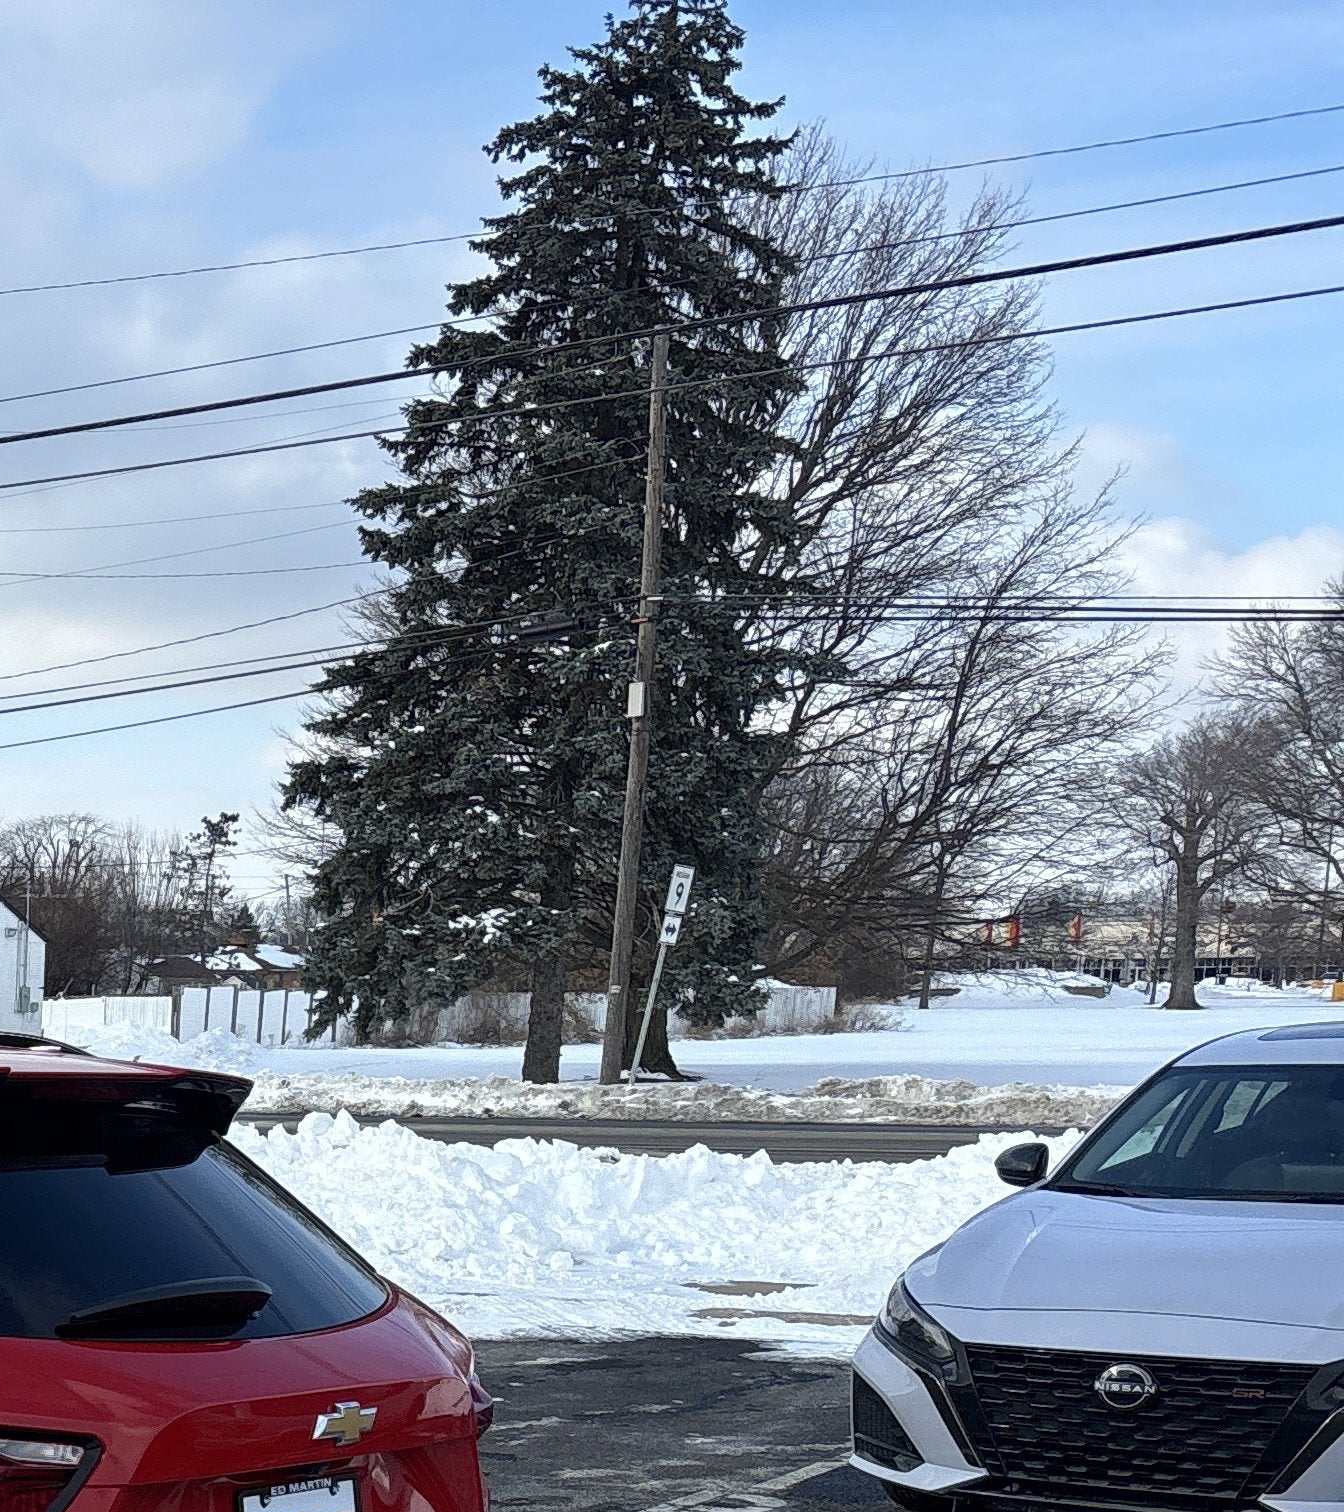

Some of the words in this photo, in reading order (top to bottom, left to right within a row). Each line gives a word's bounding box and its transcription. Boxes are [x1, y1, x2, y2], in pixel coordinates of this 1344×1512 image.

[675, 882, 685, 908] 9
[1094, 1380, 1156, 1394] NISSAN
[1231, 1387, 1265, 1399] SR
[270, 1485, 287, 1496] ED
[289, 1477, 332, 1493] MARTIN
